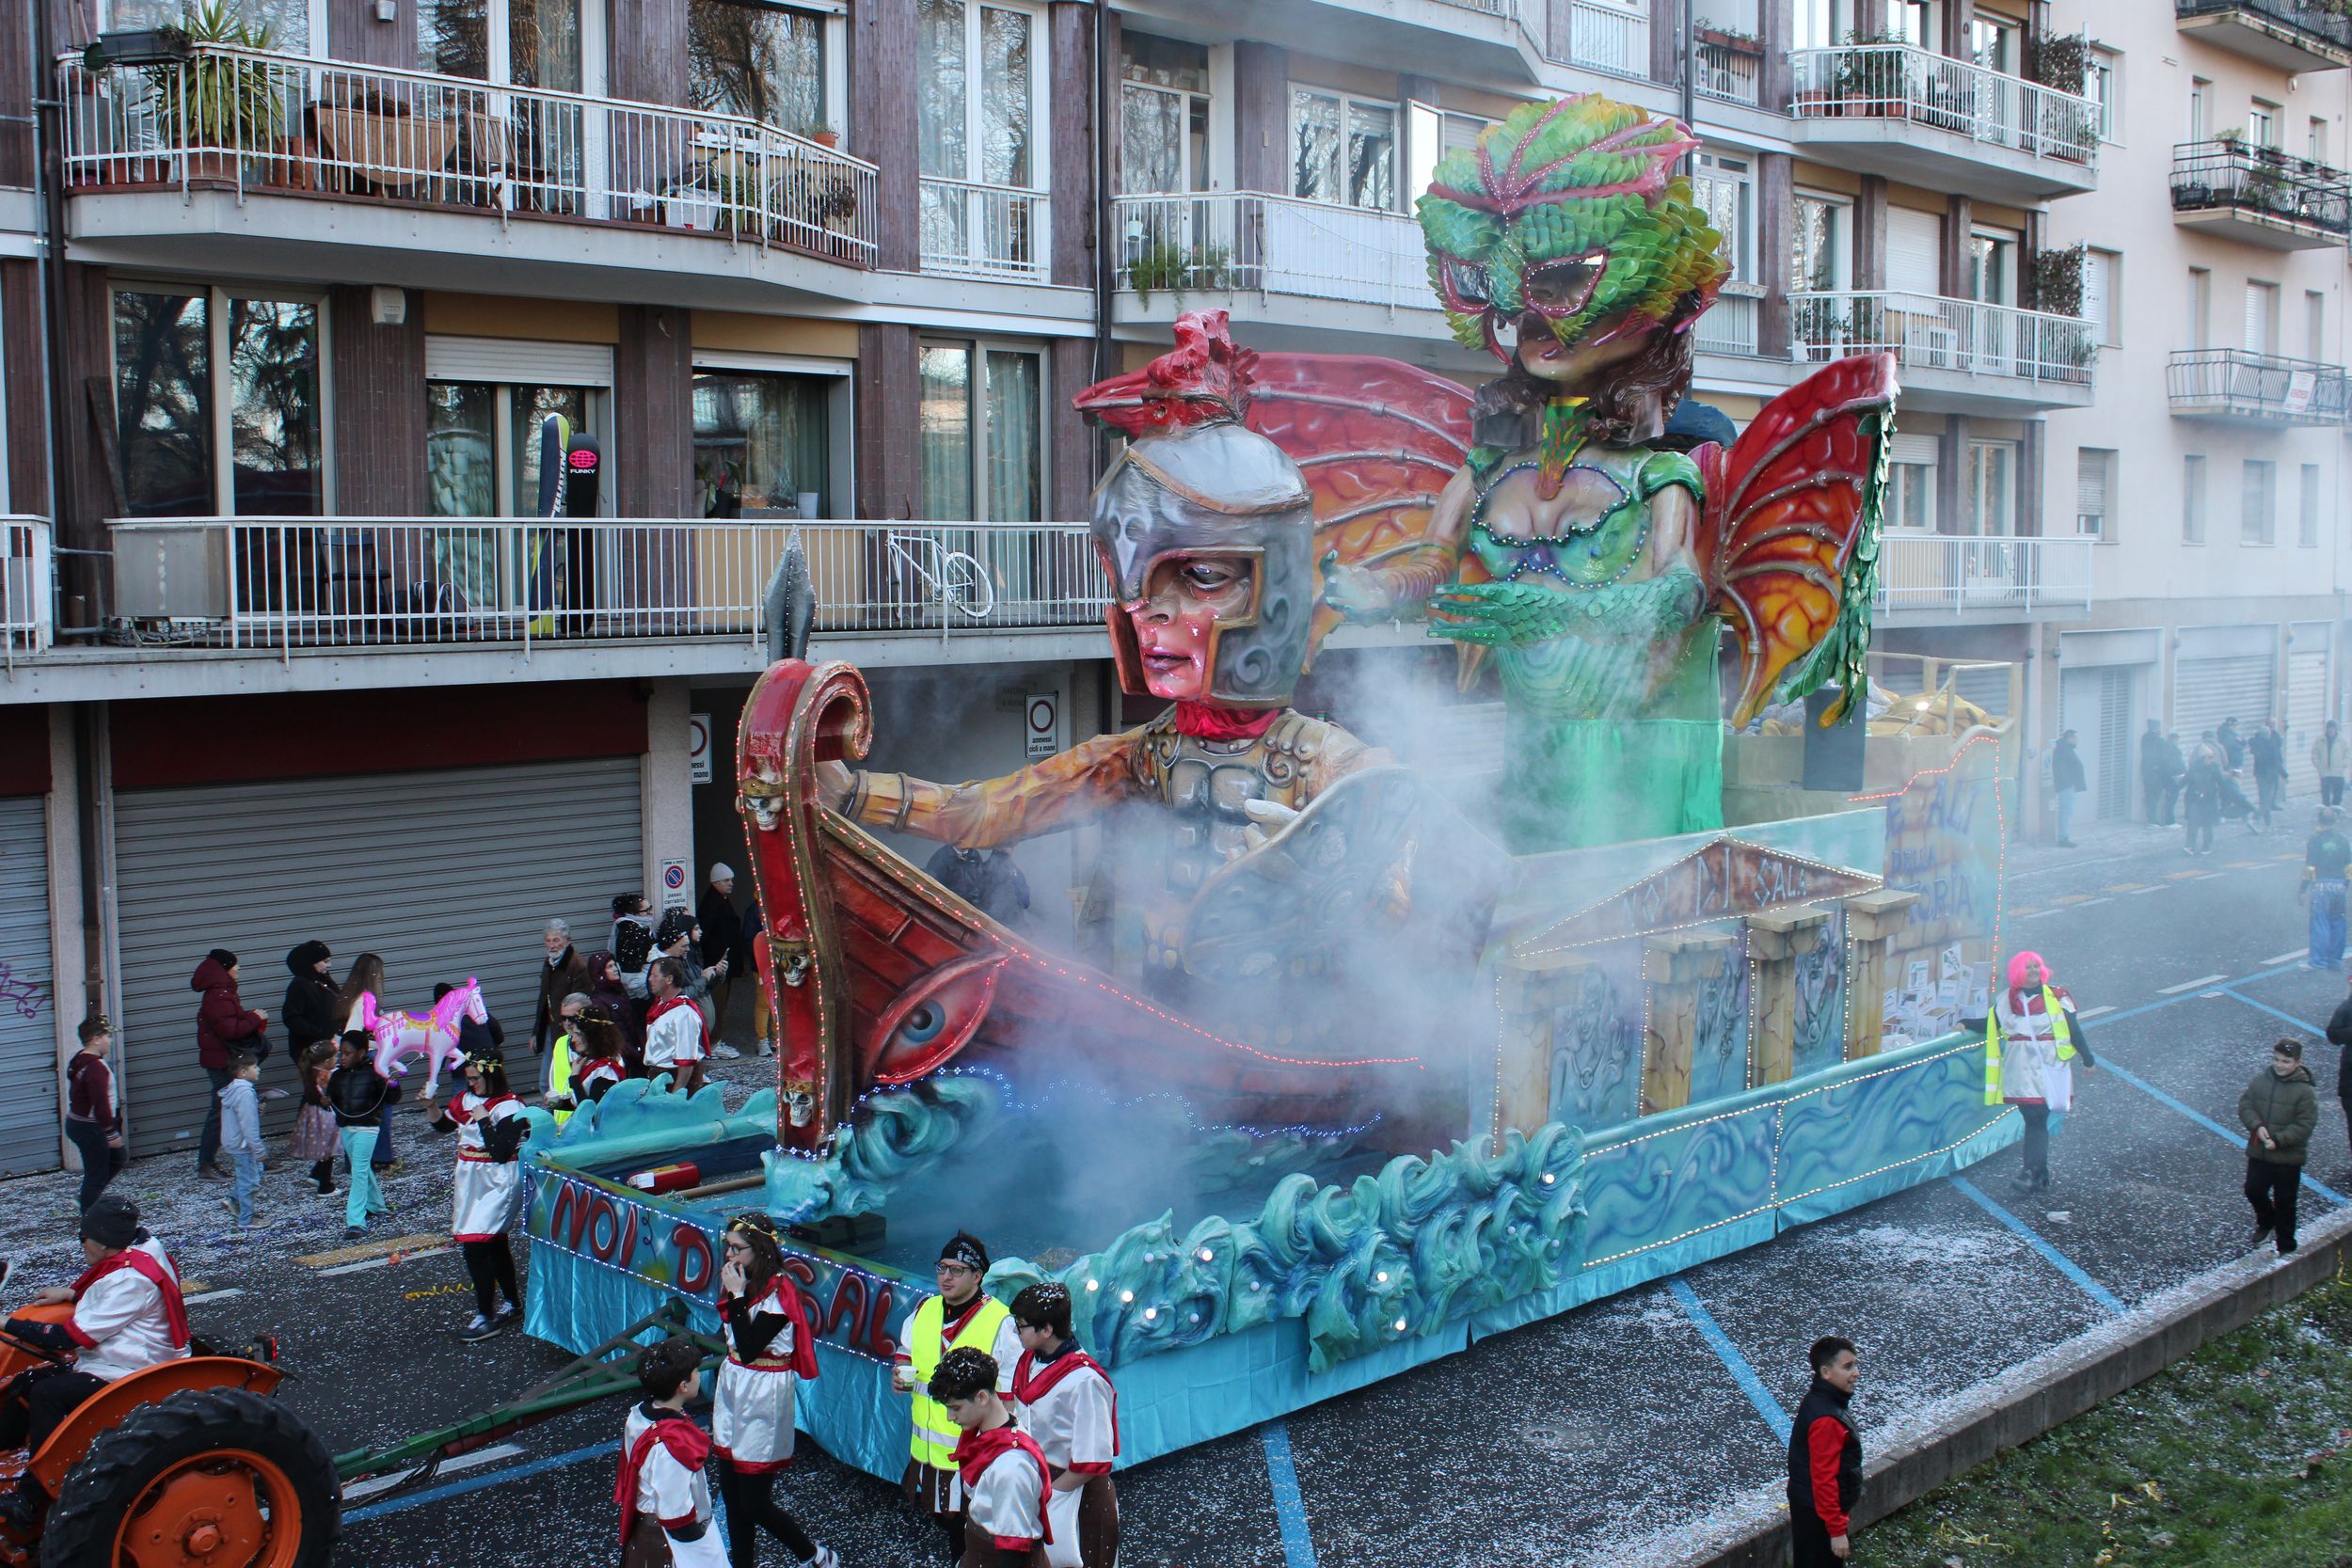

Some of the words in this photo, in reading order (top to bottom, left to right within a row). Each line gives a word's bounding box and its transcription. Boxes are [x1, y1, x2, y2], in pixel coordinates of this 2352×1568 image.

[691, 760, 705, 768] essi
[693, 770, 709, 779] mano
[1928, 776, 1979, 834] ALI
[1891, 844, 1937, 875] DELLA
[1622, 876, 1670, 927] NOI
[1695, 847, 1731, 917] DI
[1754, 857, 1808, 908] SALA
[550, 1180, 640, 1271] NOI
[672, 1223, 724, 1296] D
[784, 1255, 922, 1357] SAL
